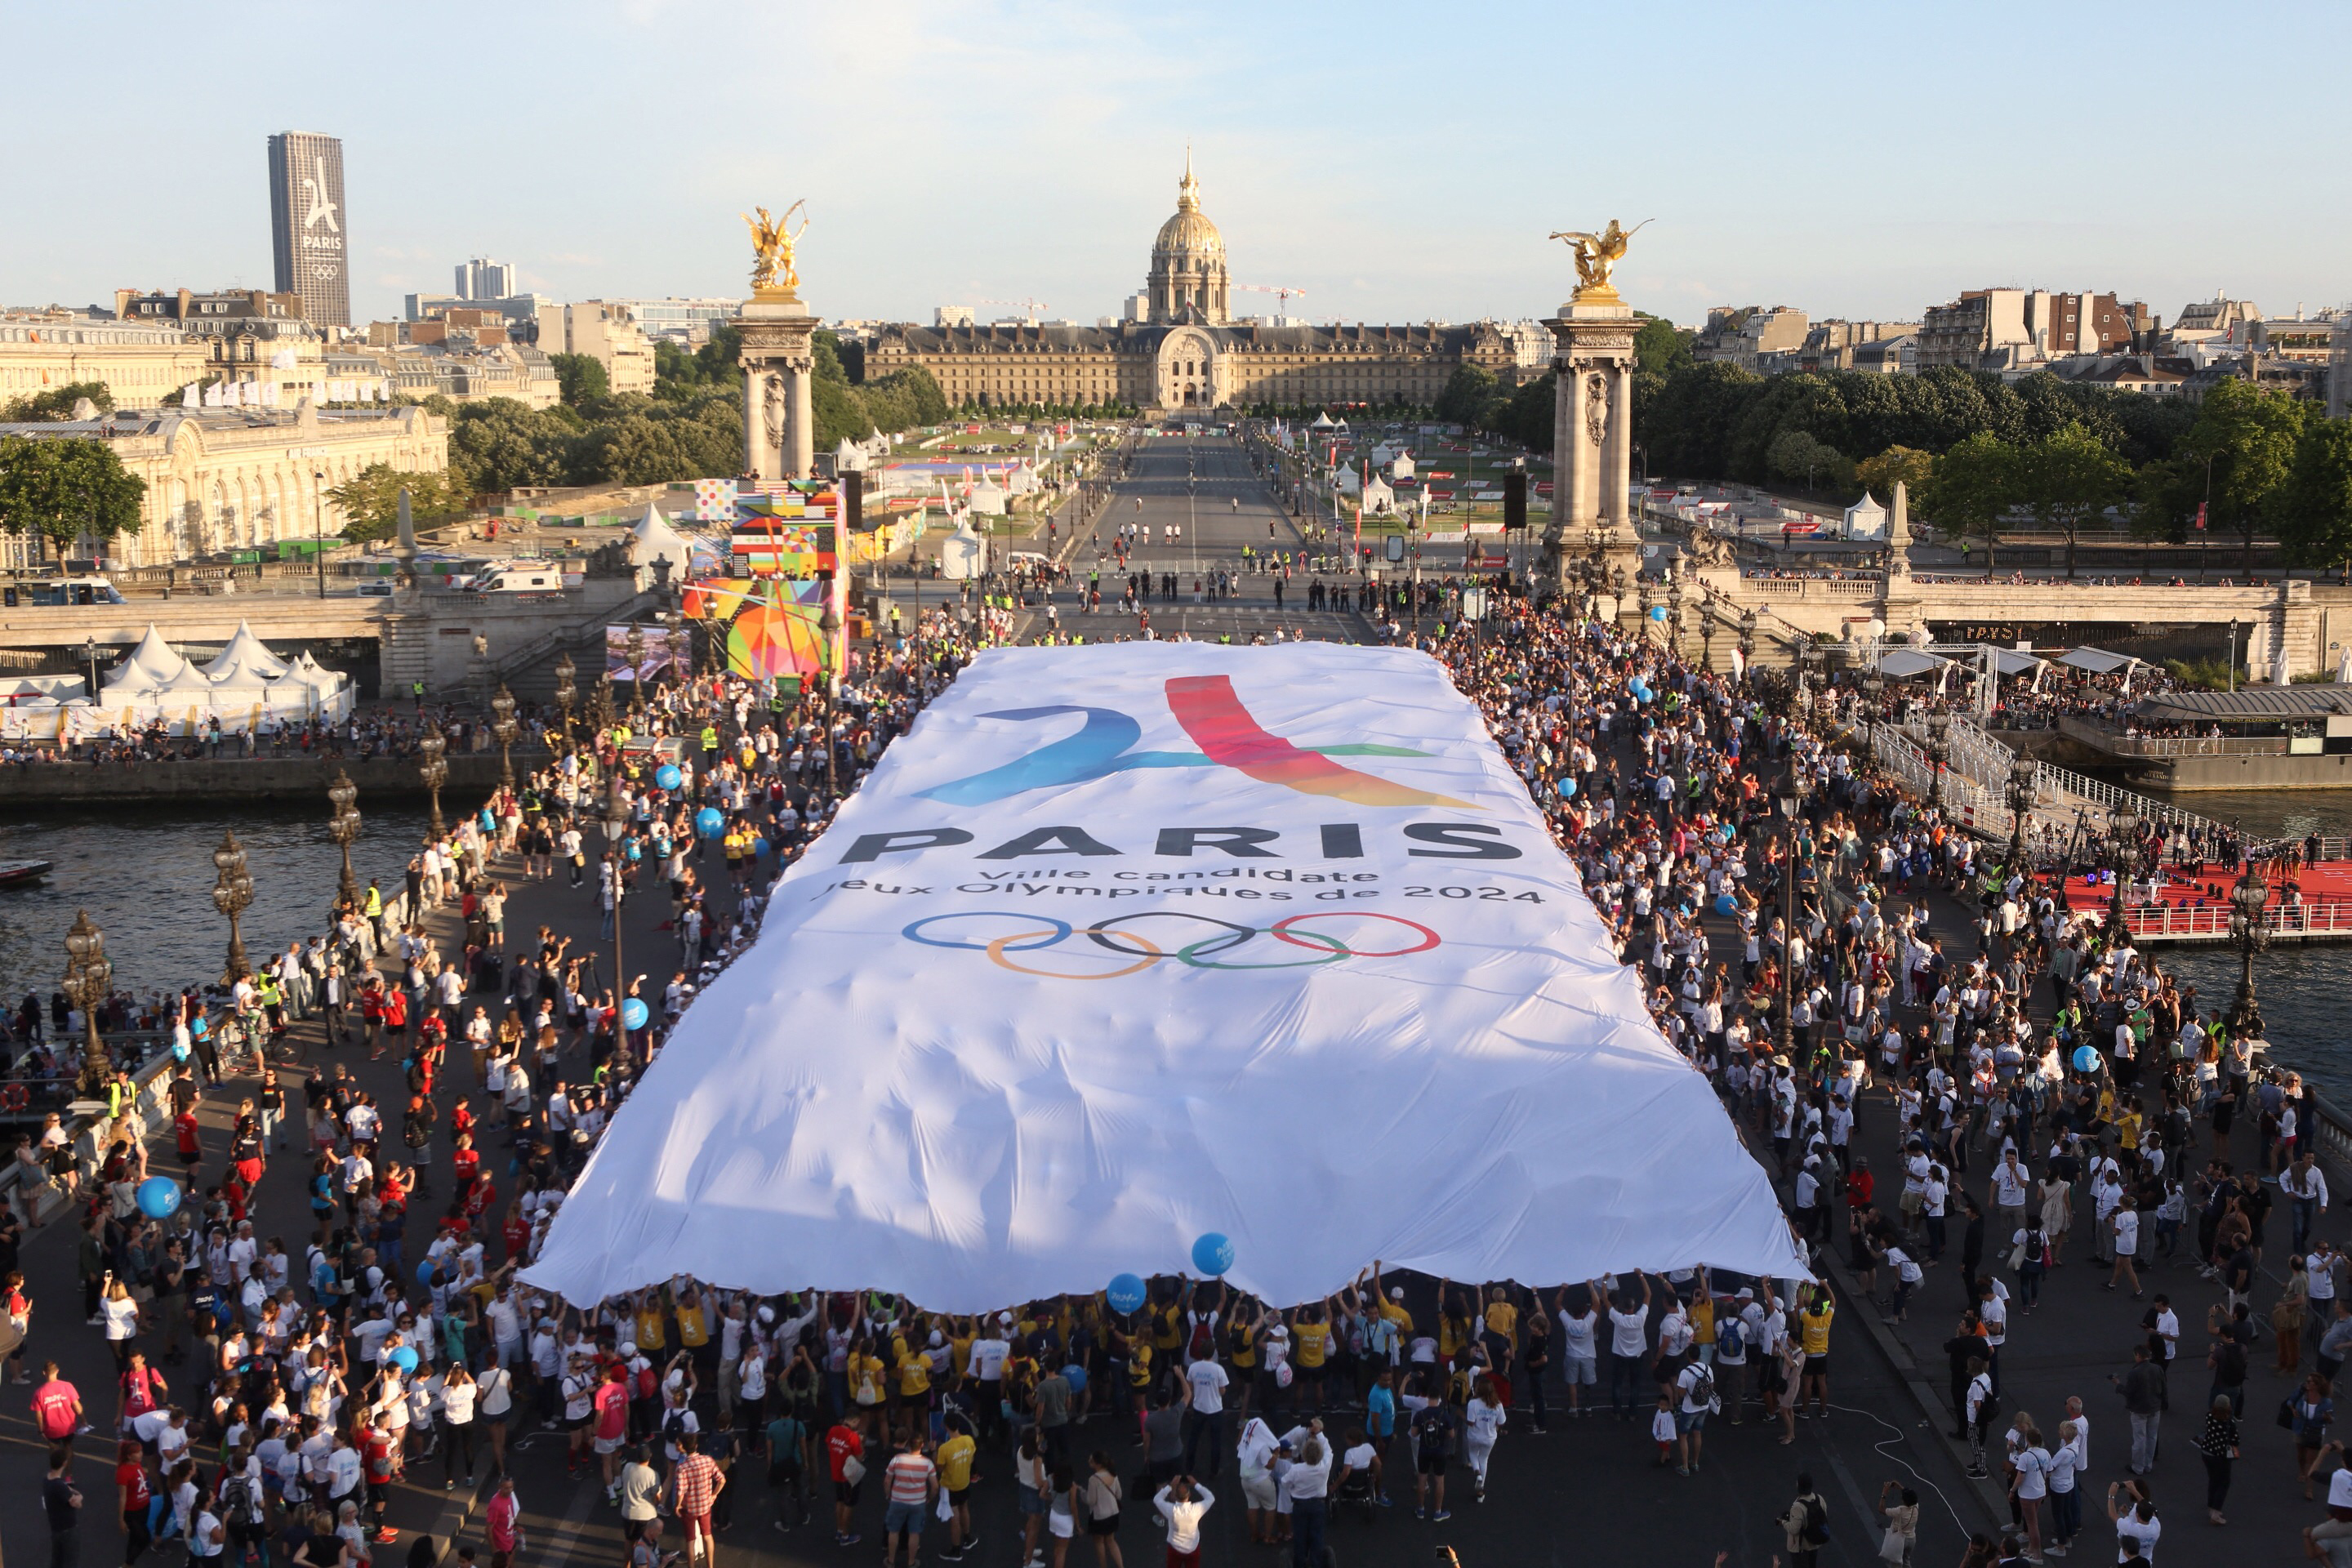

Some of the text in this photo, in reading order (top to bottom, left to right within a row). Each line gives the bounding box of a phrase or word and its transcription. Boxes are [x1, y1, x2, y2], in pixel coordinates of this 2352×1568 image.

[303, 235, 341, 250] PARIS
[288, 448, 302, 459] AIR
[838, 822, 1523, 865] PARIS
[978, 866, 1379, 883] Ville candidate
[956, 883, 1293, 900] Olympiques
[1315, 889, 1381, 899] de
[1403, 885, 1546, 904] 2024
